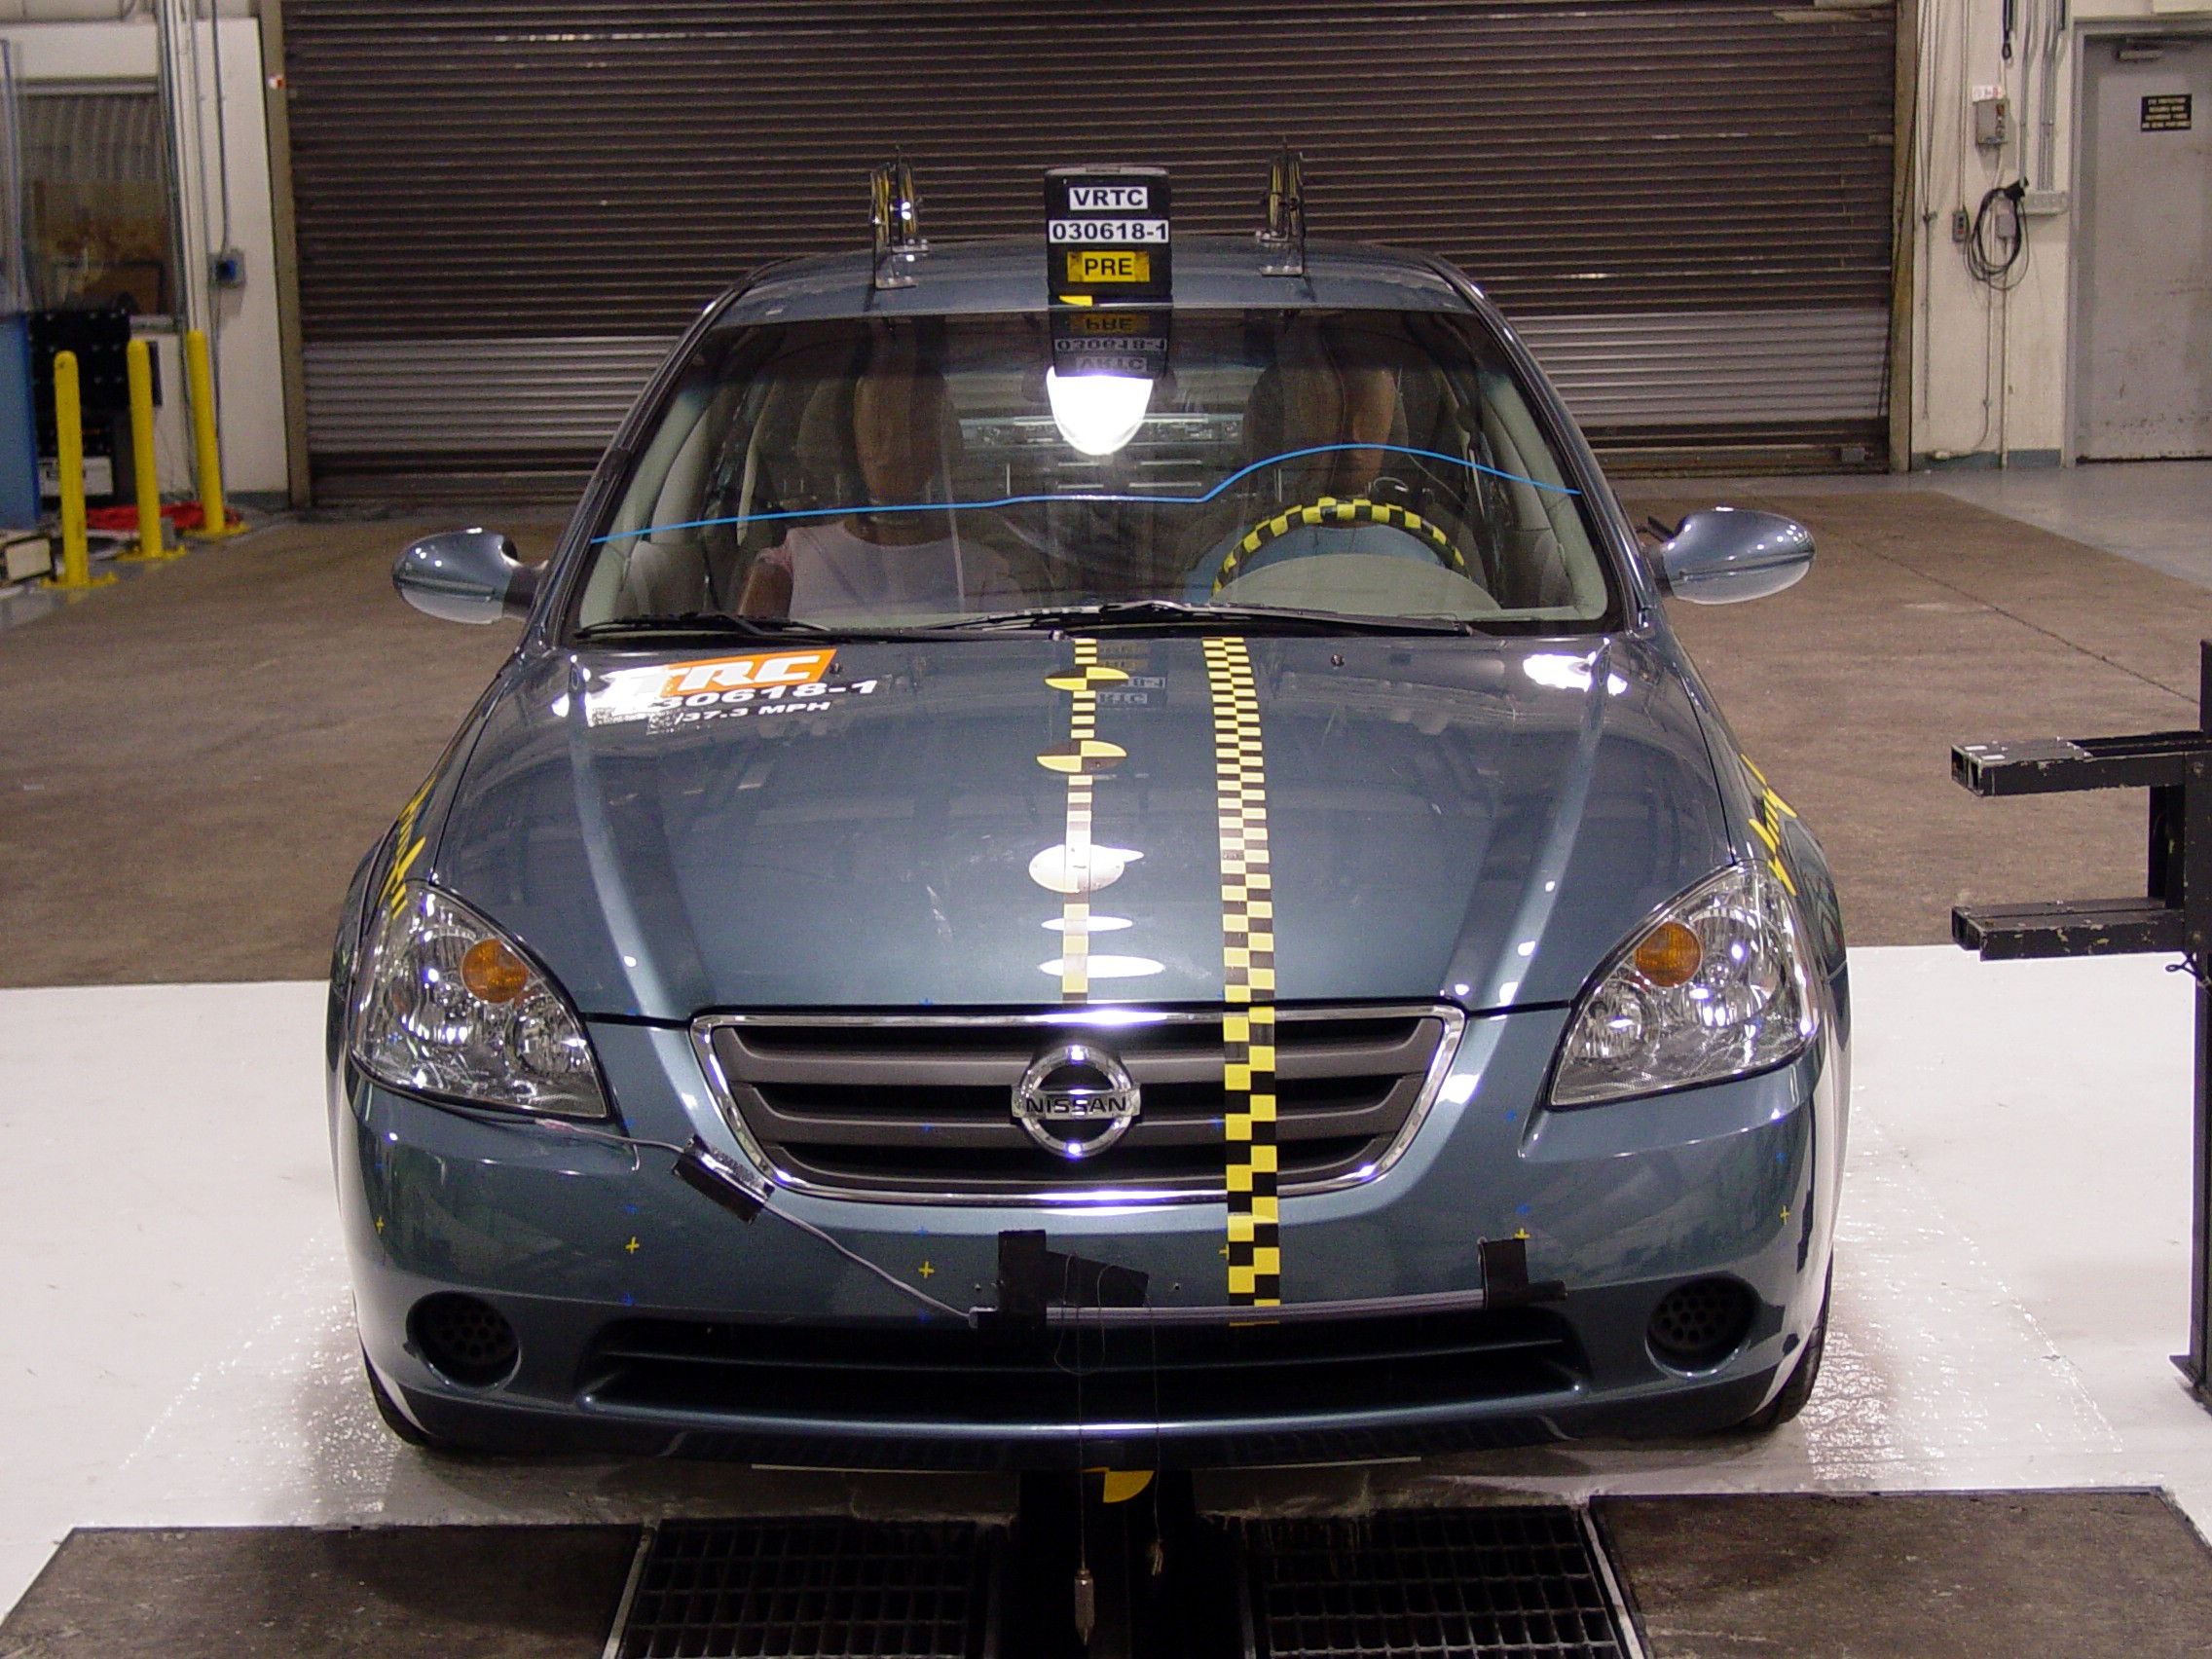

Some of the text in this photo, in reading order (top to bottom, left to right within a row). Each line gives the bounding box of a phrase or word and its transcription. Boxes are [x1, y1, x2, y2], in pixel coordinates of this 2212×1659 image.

[1073, 189, 1144, 206] VRTC
[1052, 223, 1166, 240] 030618-1
[1085, 258, 1133, 276] PRE
[757, 701, 832, 716] MPH
[1025, 1096, 1126, 1114] NISSAN
